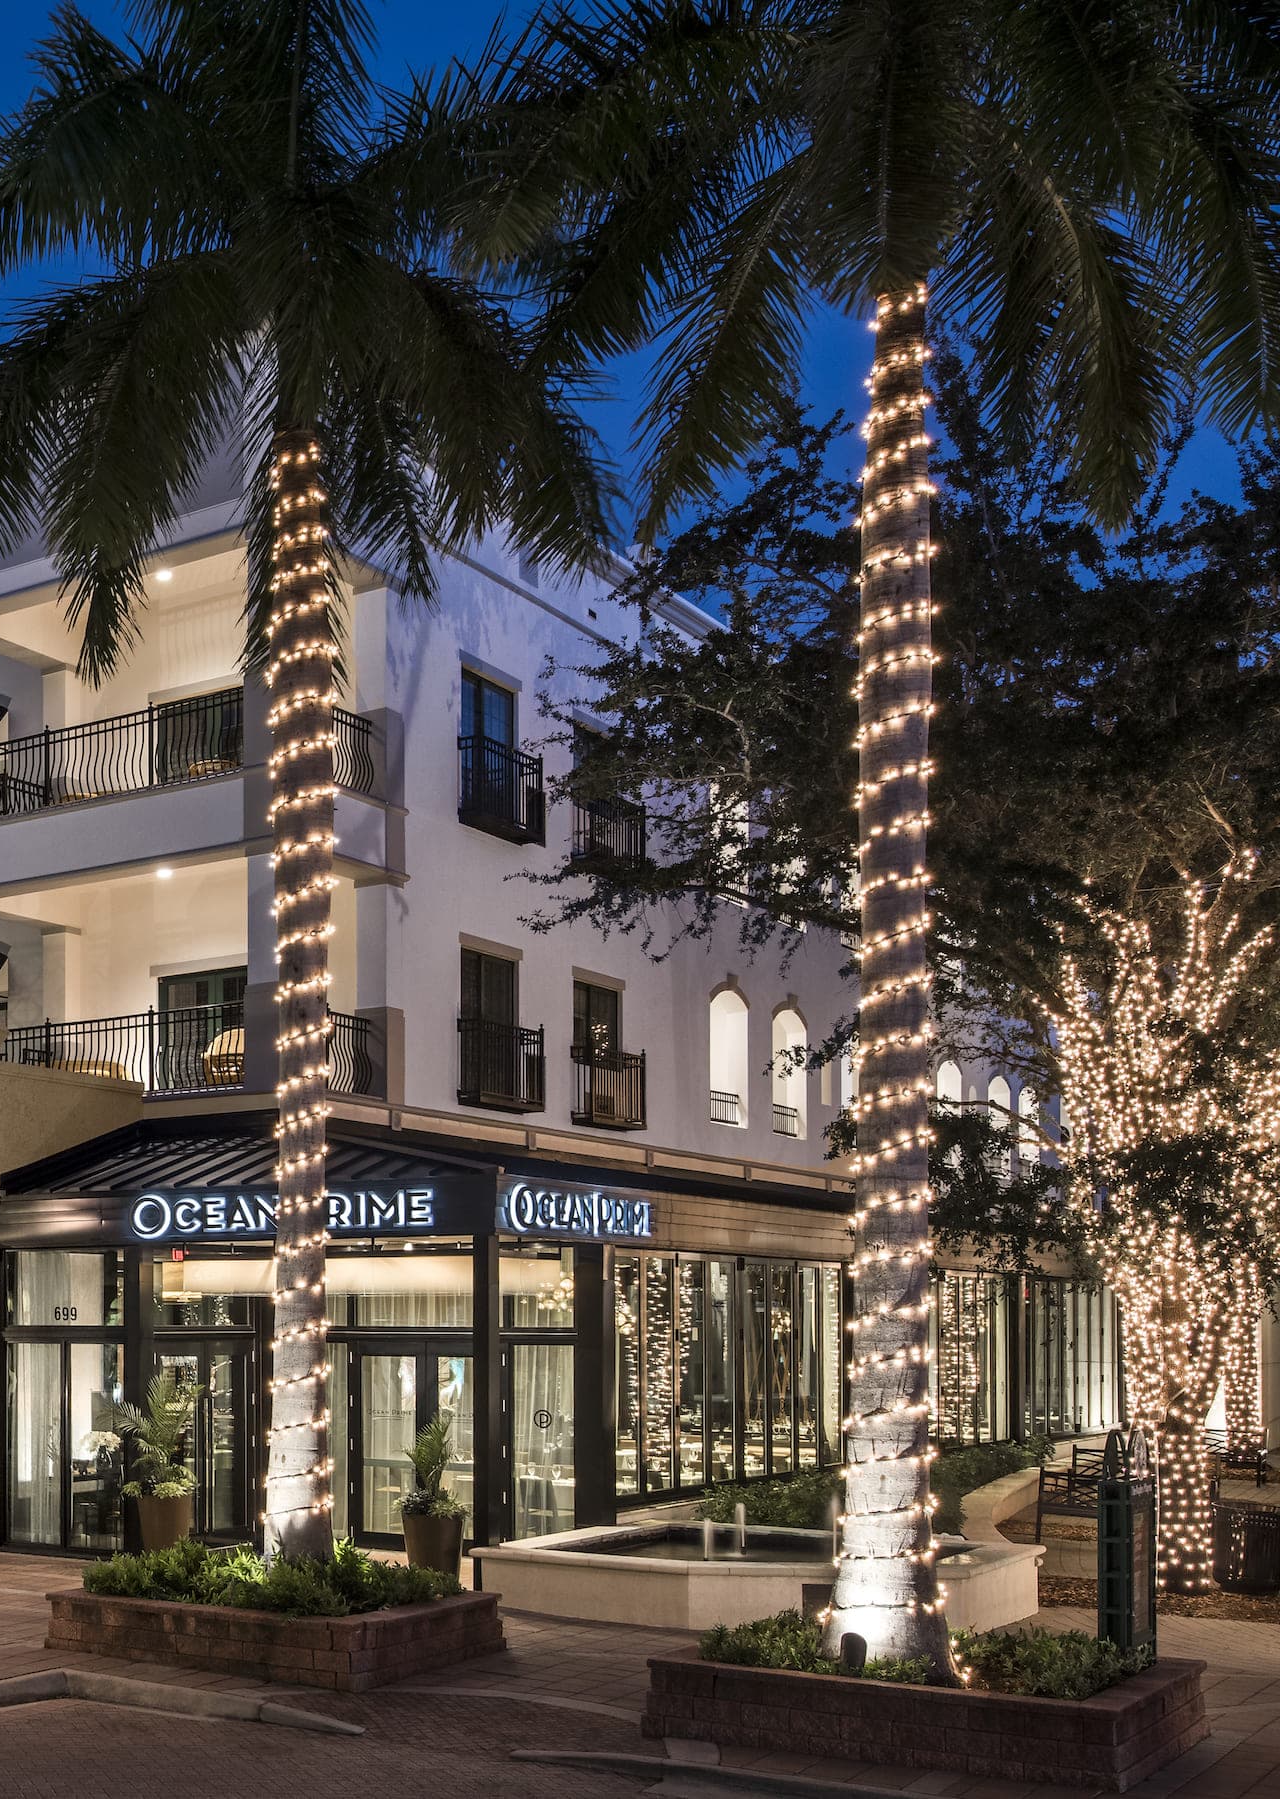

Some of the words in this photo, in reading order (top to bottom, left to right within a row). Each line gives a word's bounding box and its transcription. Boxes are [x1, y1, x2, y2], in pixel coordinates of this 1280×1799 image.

[324, 1187, 435, 1228] RIME
[509, 1182, 593, 1236] OCEAN
[54, 1306, 77, 1321] 699
